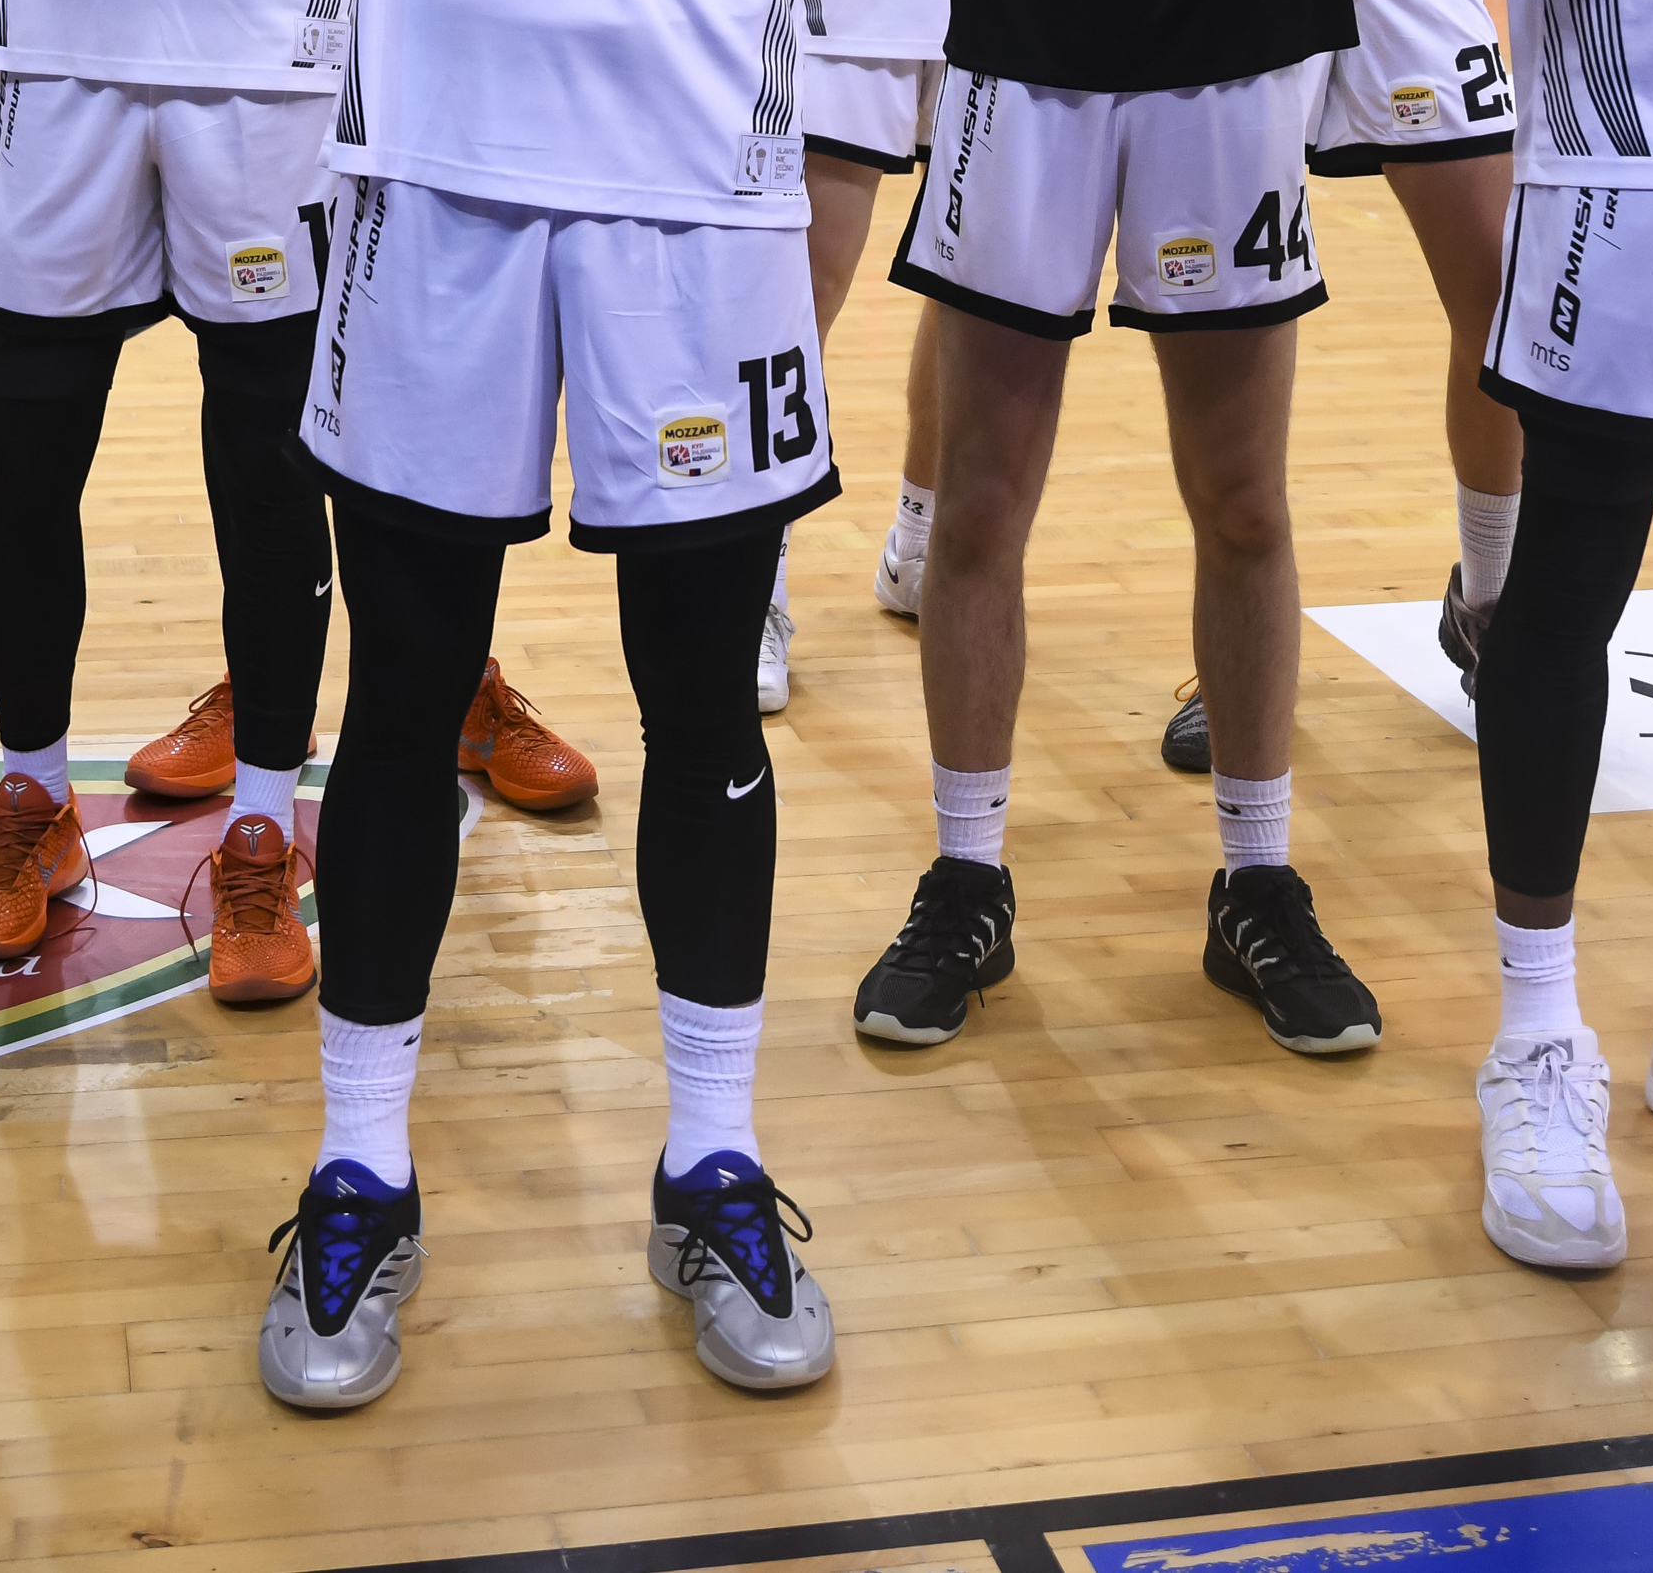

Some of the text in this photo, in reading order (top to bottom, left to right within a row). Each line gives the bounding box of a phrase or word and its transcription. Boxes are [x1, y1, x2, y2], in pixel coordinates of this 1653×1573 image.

[4, 78, 21, 151] GROUP
[954, 72, 985, 185] MILSPE
[1393, 91, 1430, 101] MOZZART
[234, 252, 279, 265] MOZZART
[297, 196, 338, 291] 1
[337, 175, 370, 340] MILSPED
[364, 190, 388, 283] GROUP
[1162, 244, 1209, 256] MOZZART
[1563, 186, 1594, 287] MILSP
[1530, 340, 1571, 373] mts
[664, 424, 720, 439] MOZZART
[738, 345, 819, 474] 13
